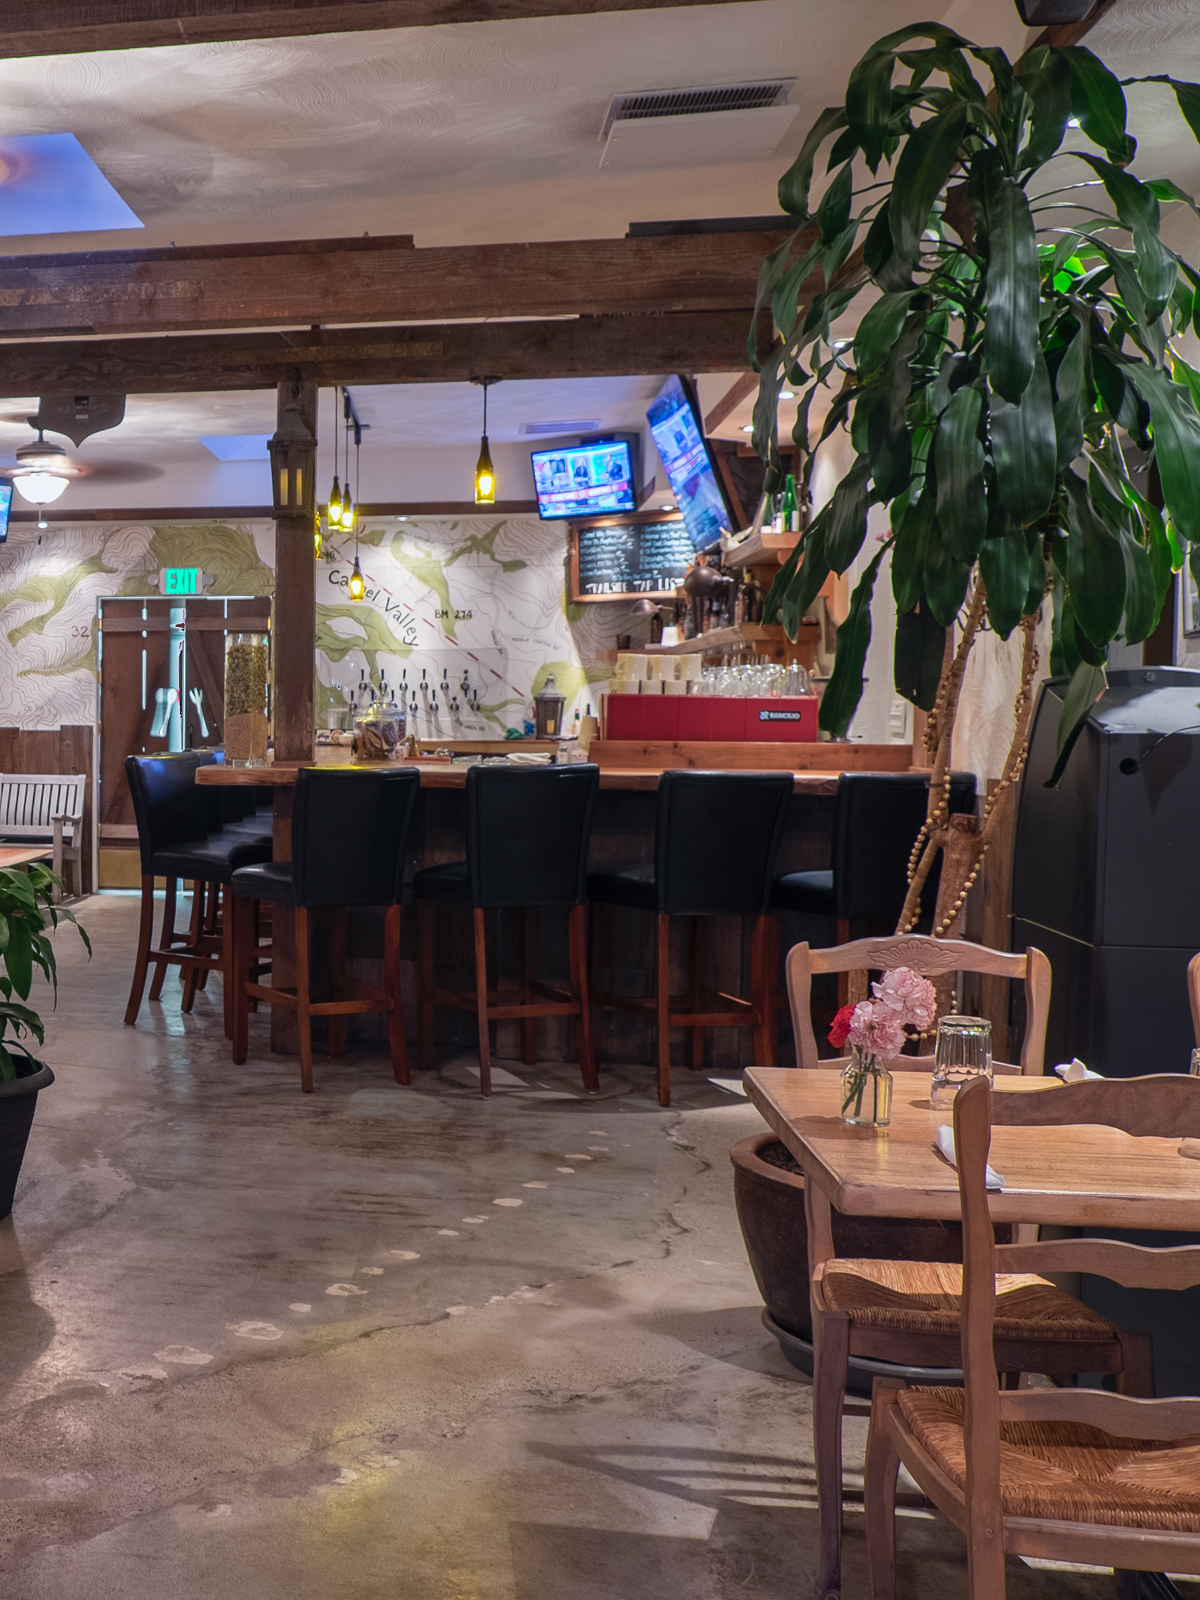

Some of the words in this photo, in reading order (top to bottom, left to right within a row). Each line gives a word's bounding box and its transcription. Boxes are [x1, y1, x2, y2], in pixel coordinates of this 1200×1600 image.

[166, 568, 198, 594] EXIT
[328, 570, 380, 601] Cael
[385, 597, 419, 647] Valley
[434, 610, 449, 619] BM
[455, 610, 473, 619] 274
[71, 625, 90, 638] 32
